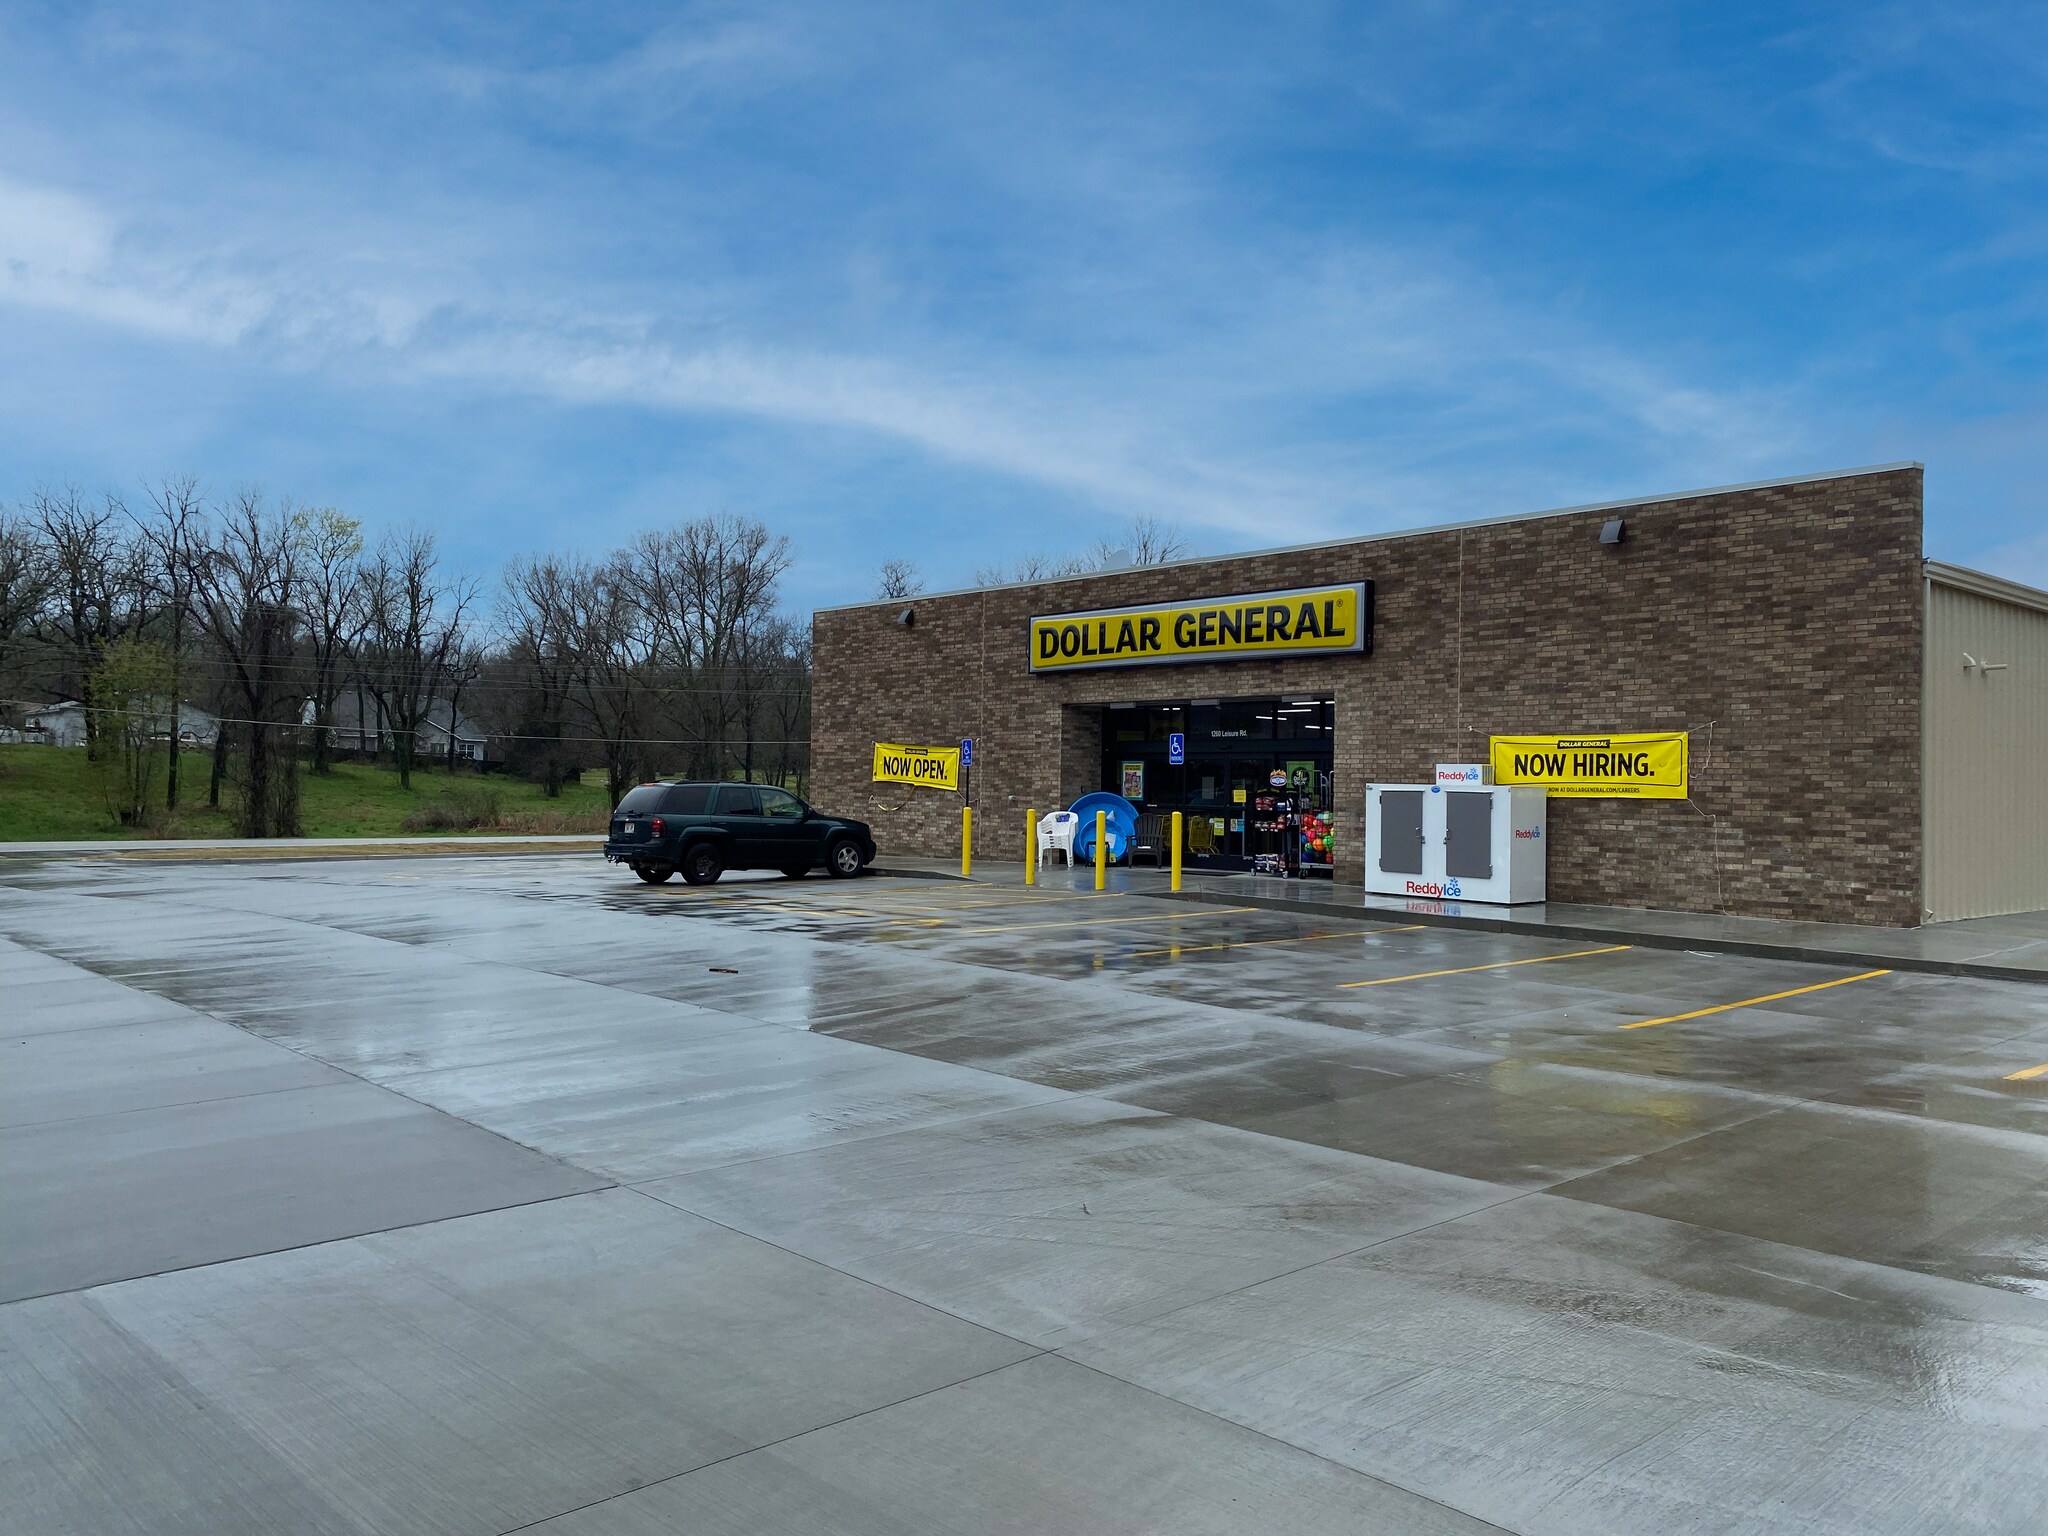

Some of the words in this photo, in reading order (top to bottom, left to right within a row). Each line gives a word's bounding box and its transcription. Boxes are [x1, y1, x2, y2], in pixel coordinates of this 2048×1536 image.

[1038, 616, 1162, 660] DOLLAR
[1559, 740, 1582, 748] DOLLAR
[883, 756, 912, 777] NOW
[913, 758, 948, 780] OPEN.
[1514, 753, 1567, 777] NOW
[1573, 752, 1655, 777] HIRING.
